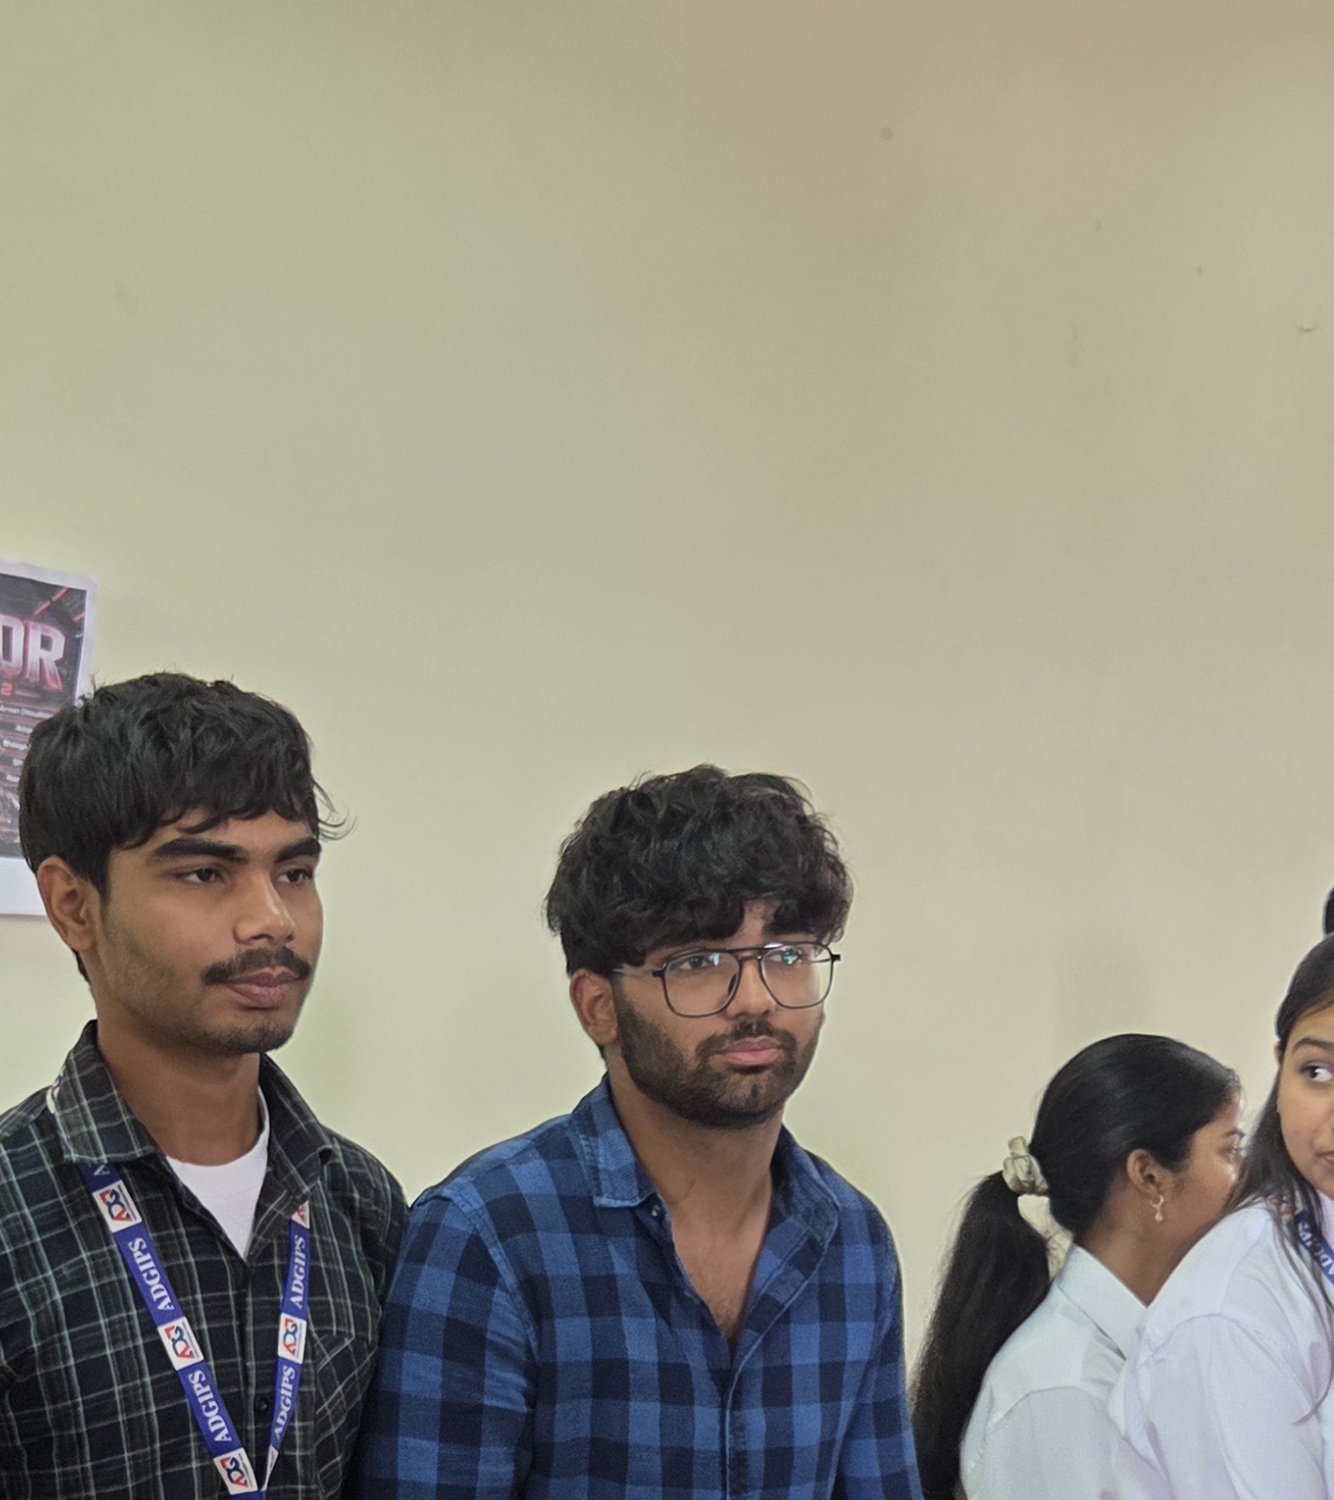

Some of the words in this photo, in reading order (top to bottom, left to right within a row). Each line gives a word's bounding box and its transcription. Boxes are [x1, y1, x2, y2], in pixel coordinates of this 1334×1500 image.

[1, 683, 13, 696] 2
[127, 1236, 175, 1311] ADGIPS
[290, 1235, 306, 1309] ADGIPS
[188, 1370, 232, 1443] ADGIPS
[275, 1364, 296, 1441] ADGIPS
